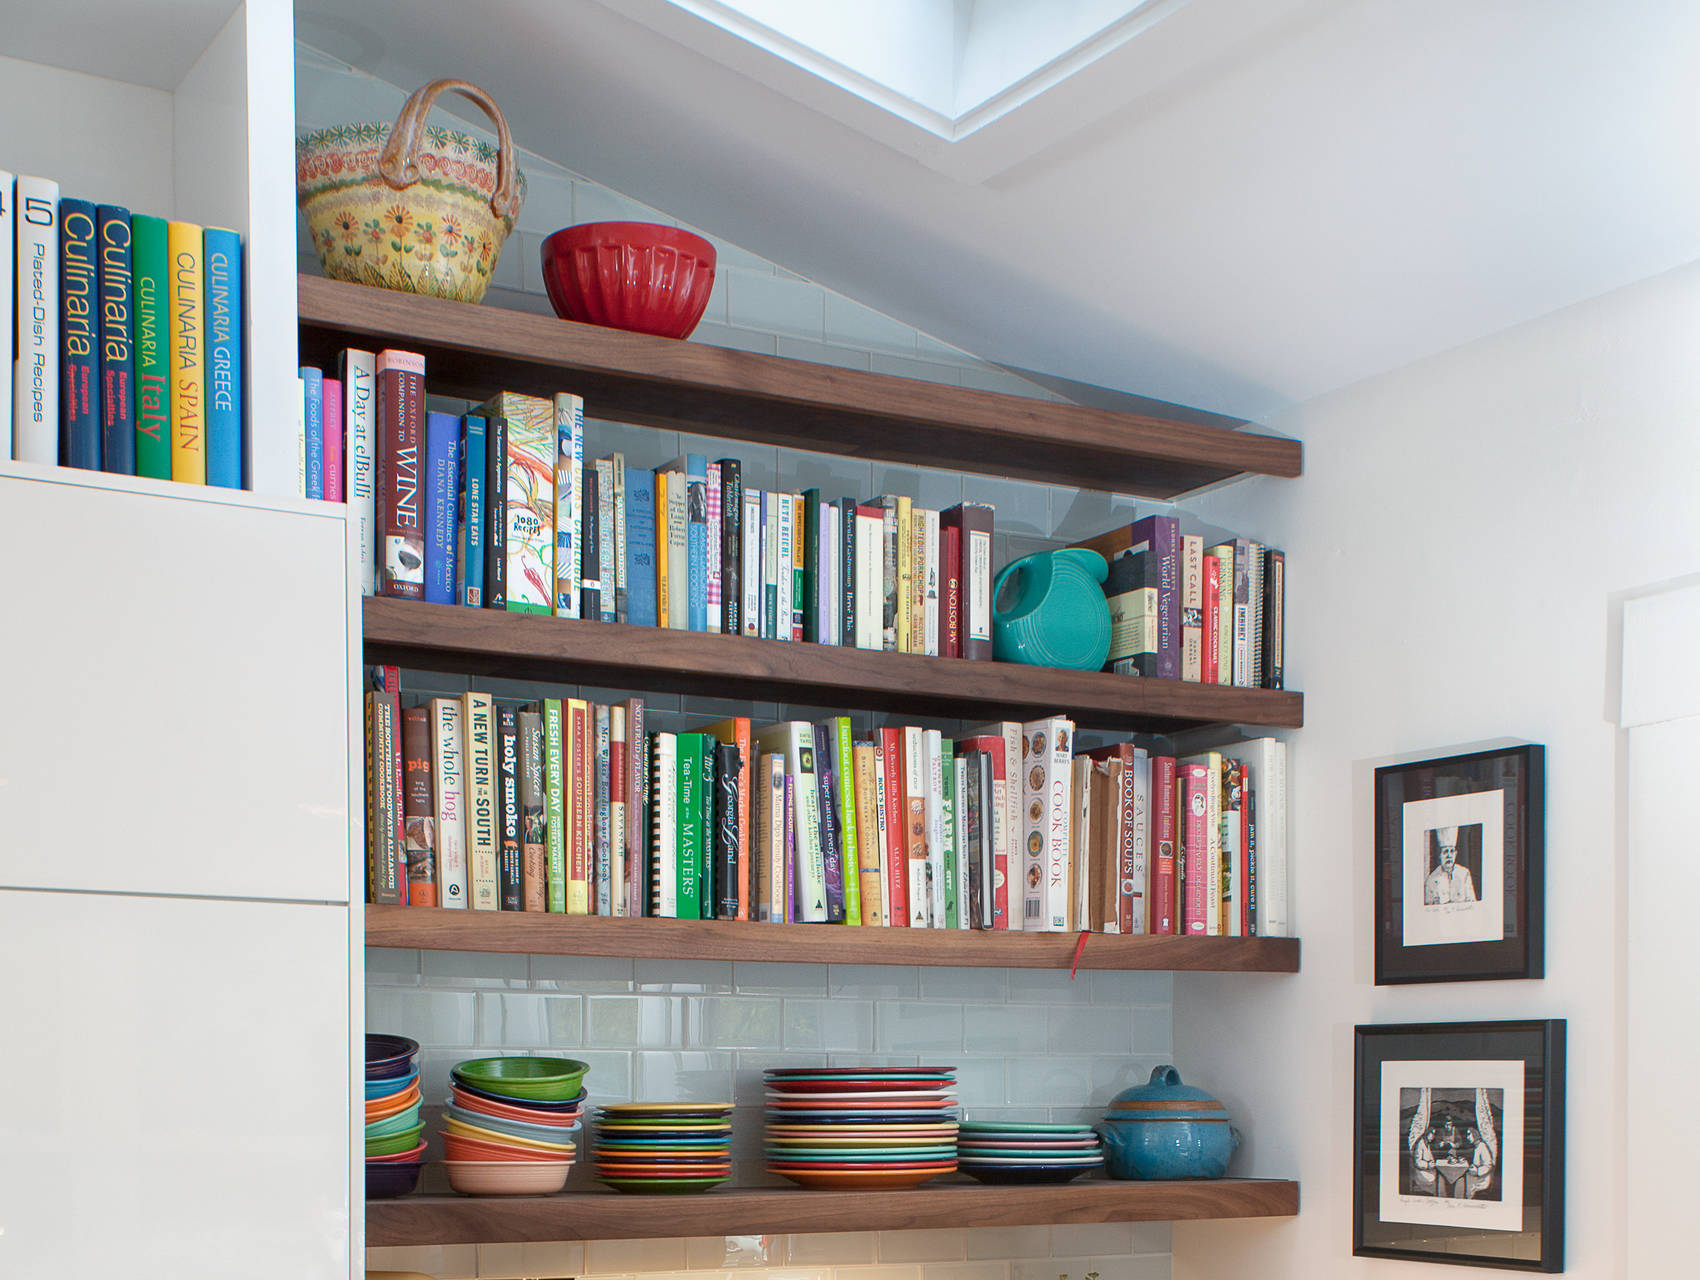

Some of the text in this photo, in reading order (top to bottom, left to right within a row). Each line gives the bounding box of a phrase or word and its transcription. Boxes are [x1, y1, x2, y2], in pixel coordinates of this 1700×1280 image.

[25, 197, 53, 227] 5
[64, 212, 96, 356] Culinaria
[103, 219, 132, 361] Culinaria
[31, 242, 45, 422] Plated-Dish Recipes
[177, 252, 199, 452] CULINARIA SPAIN
[211, 252, 232, 411] CULINARIA GREECE
[136, 276, 167, 442] CULINARIA Italy
[80, 365, 90, 414] European
[106, 369, 116, 426] Specialties
[118, 371, 128, 420] European
[310, 377, 319, 395] The
[409, 375, 417, 444] THE OXFORD
[310, 398, 319, 428] Foods
[310, 430, 320, 440] of
[352, 366, 370, 499] A Day at elBulli
[574, 407, 584, 430] THE
[311, 442, 320, 458] the
[395, 371, 418, 529] COMPANION TO WINE
[574, 434, 583, 463] NEW
[311, 460, 320, 491] Greek
[329, 464, 337, 500] curries
[725, 481, 734, 518] Tablecloth
[435, 458, 445, 549] DIANA KENNEDY
[445, 440, 457, 593] The Essential Cuisines Mexico
[470, 478, 479, 547] LONE STAR EATS
[517, 514, 539, 526] 1080
[616, 495, 624, 534] SAVAGE
[732, 473, 741, 527] Charlemagne's
[781, 499, 790, 559] RUTH REICHL
[393, 582, 419, 594] OXFORD
[690, 525, 698, 608] SOUTHERN COOKING
[1189, 540, 1197, 604] LAST CALL
[949, 590, 957, 629] BOSTON
[1159, 555, 1171, 650] World Vegetarian
[441, 706, 458, 732] the
[472, 699, 486, 709] A
[634, 704, 642, 722] NOT
[377, 703, 385, 761] COMMUNITY
[473, 713, 488, 745] NEW
[634, 723, 642, 754] AFRAID
[841, 725, 851, 765] barefoot
[889, 742, 896, 752] My
[378, 761, 386, 809] COOKBOOK
[407, 757, 431, 773] pig
[442, 737, 460, 785] whole
[475, 749, 489, 786] TURN
[529, 728, 541, 798] Susan Spicer
[549, 709, 561, 813] FRESH EVERY DAY
[633, 761, 642, 793] FLAVOR
[682, 757, 693, 804] Tea-Time
[889, 754, 897, 778] Beverly
[1009, 728, 1019, 822] Fish & Shellfish
[384, 704, 395, 889] THE SOUTHERN FOODWAYS ALLIANCE
[441, 791, 461, 822] hog
[502, 735, 518, 838] holy smoke
[575, 775, 583, 826] SOUTHERN
[599, 726, 610, 883] Mrs. Boardinghouse Cookbook
[809, 789, 817, 815] heart
[843, 766, 853, 808] contessa
[476, 797, 491, 847] SOUTH
[617, 806, 625, 858] SAVANNAH
[721, 773, 739, 865] Georgia Land
[812, 825, 820, 840] the
[822, 775, 838, 873] super natural every day
[878, 804, 886, 832] BISTRO
[942, 799, 953, 853] FARM
[1050, 780, 1064, 889] COOK BOOK
[1124, 770, 1133, 874] BOOK OF SOUPS
[1135, 793, 1144, 873] SAUCES
[526, 848, 537, 878] Cooking
[575, 829, 583, 874] KITCHEN
[814, 842, 823, 886] artichoke
[847, 848, 857, 875] basics
[1209, 846, 1217, 886] Continual
[1248, 849, 1256, 874] pickle
